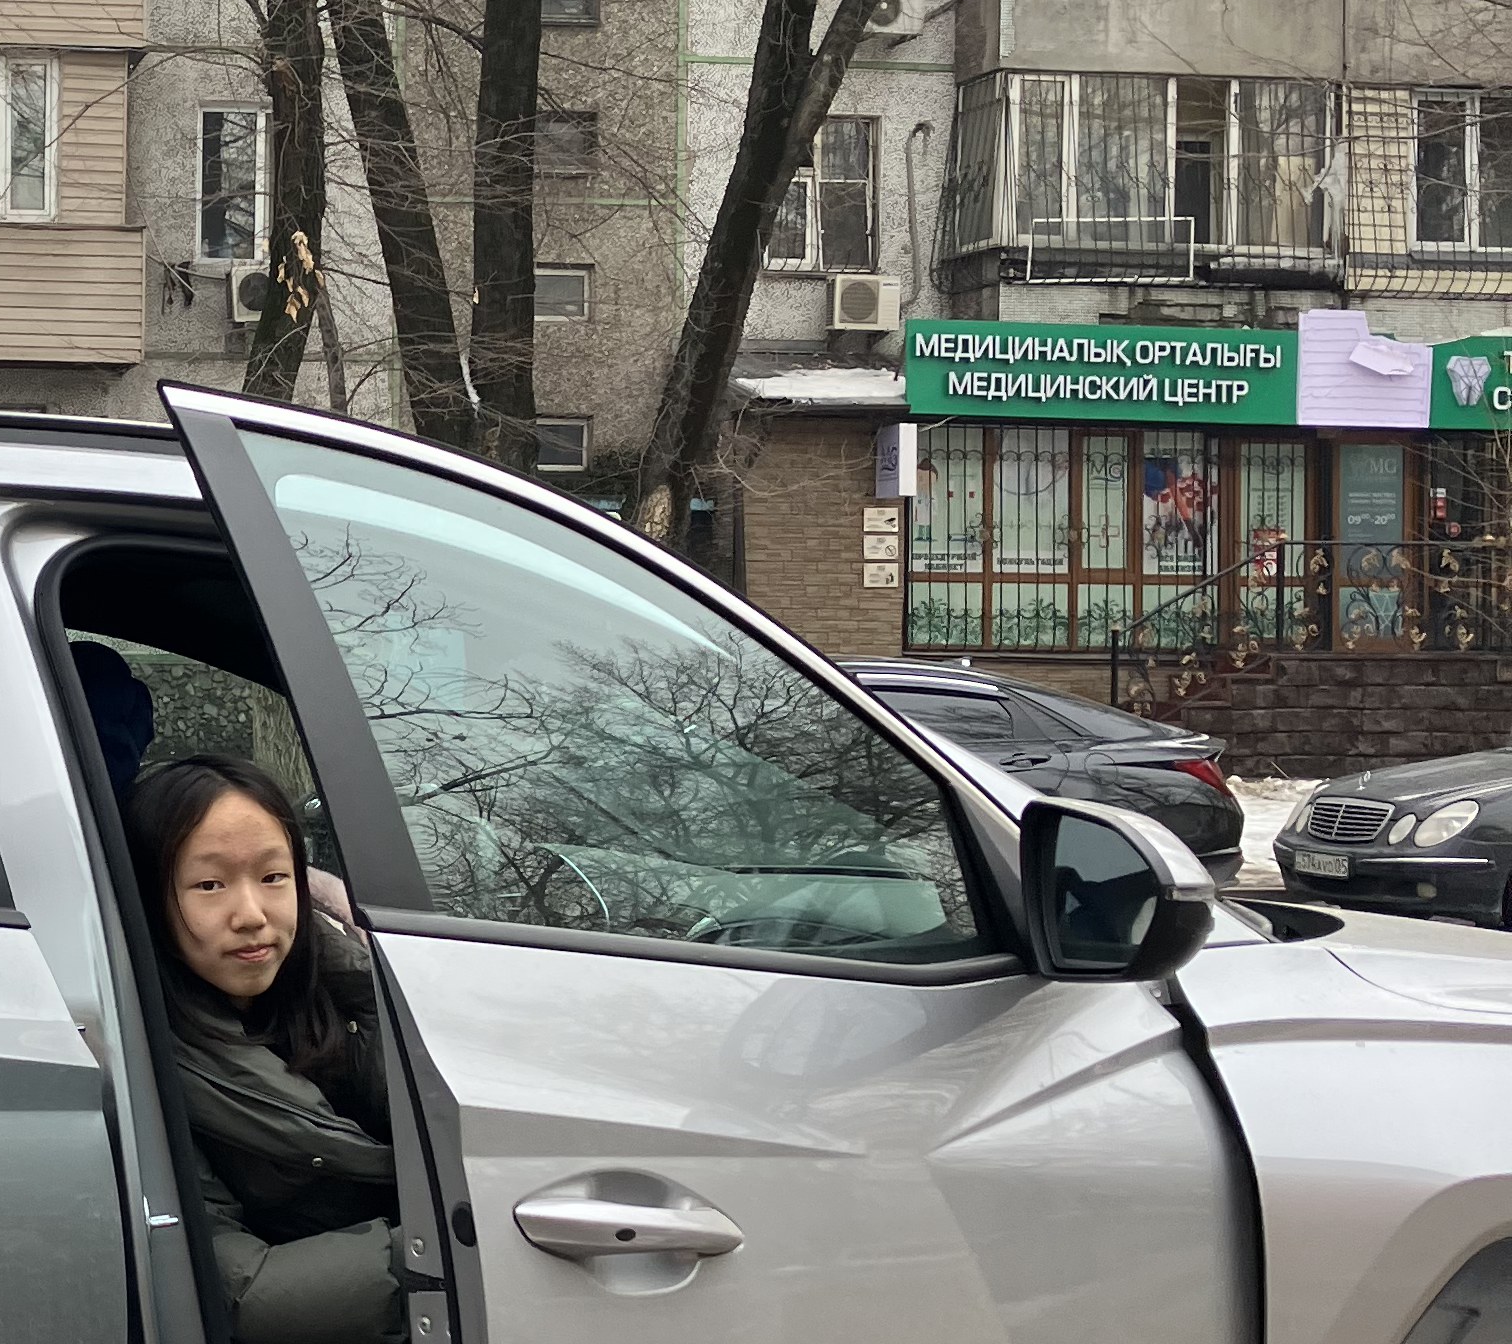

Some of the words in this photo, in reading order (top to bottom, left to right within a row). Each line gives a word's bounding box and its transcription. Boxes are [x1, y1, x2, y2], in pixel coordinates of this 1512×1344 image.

[915, 333, 1132, 367] МЕДИЦИНАЛЫҚ
[1135, 341, 1281, 368] ОРТАЛЫҒЫ
[948, 371, 1157, 402] МЕДИЦИНСКИЙ
[1164, 378, 1249, 406] ЦЕНТР
